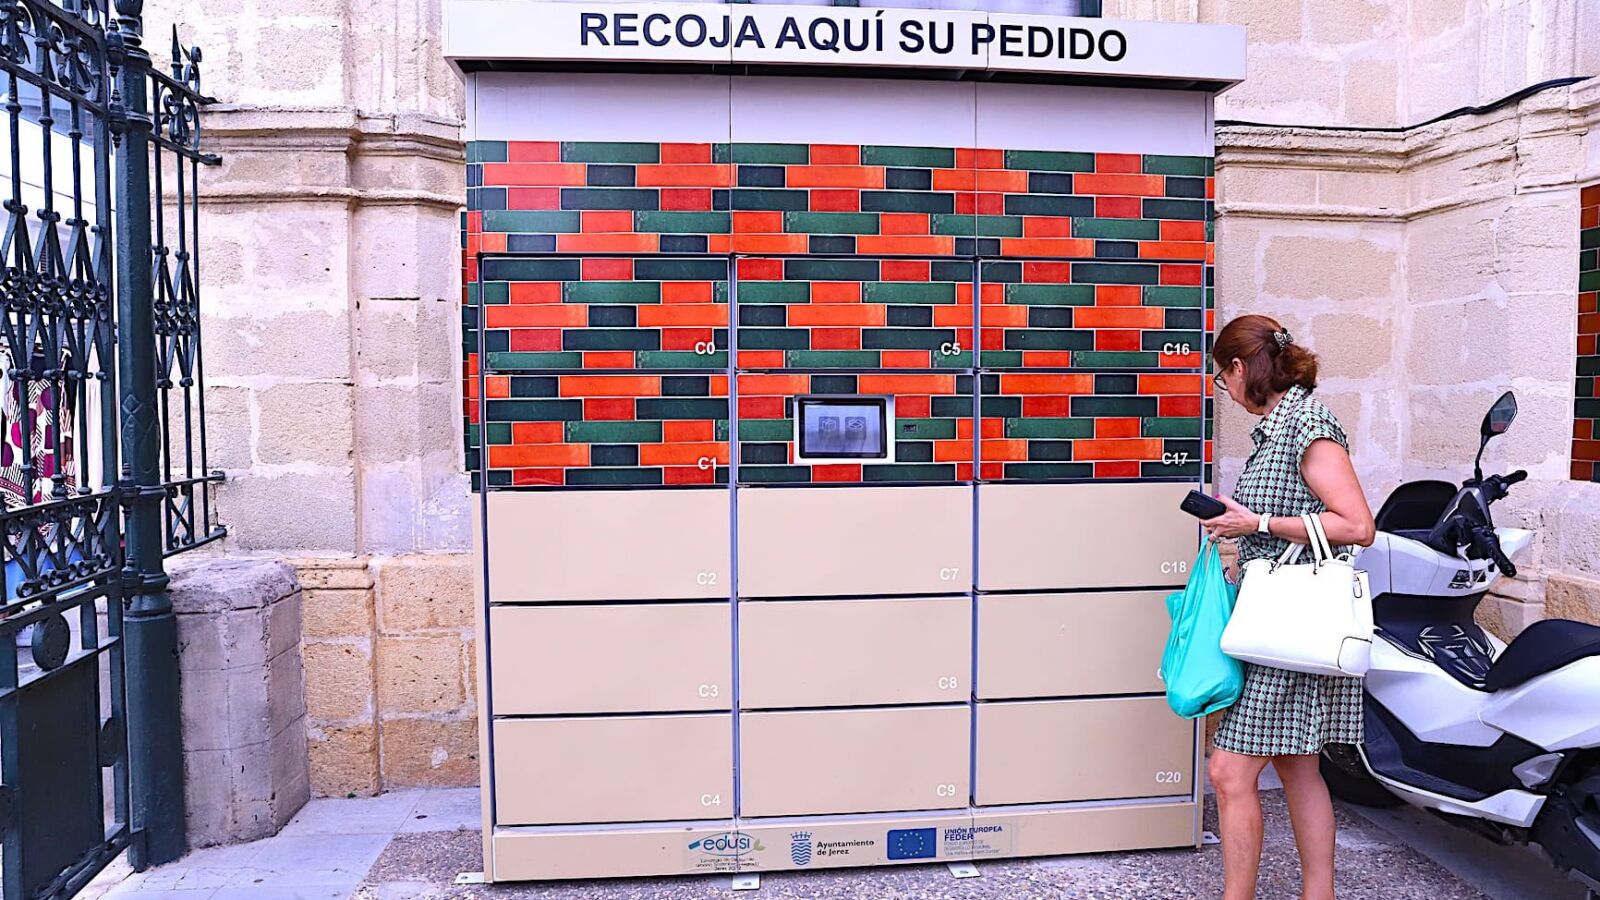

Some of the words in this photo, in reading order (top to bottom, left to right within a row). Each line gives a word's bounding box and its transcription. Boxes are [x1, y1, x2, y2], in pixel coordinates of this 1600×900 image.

[580, 12, 766, 48] RECOJA
[774, 10, 883, 53] AQUÍ
[898, 19, 954, 54] SU
[971, 22, 1127, 62] PEDIDO
[694, 341, 716, 355] C0
[940, 342, 961, 356] C5
[1162, 342, 1190, 356] C16
[698, 456, 716, 470] C1
[1161, 452, 1187, 464] C17
[939, 567, 959, 580] C7
[1160, 561, 1187, 574] C18
[696, 572, 717, 585] C2
[938, 676, 958, 689] C8
[698, 684, 719, 697] C3
[1155, 771, 1181, 783] C20
[936, 784, 956, 797] C9
[701, 794, 721, 806] C4
[703, 835, 750, 851] edusi
[944, 833, 974, 841] FEDER
[816, 840, 875, 850] Ayuntamiento
